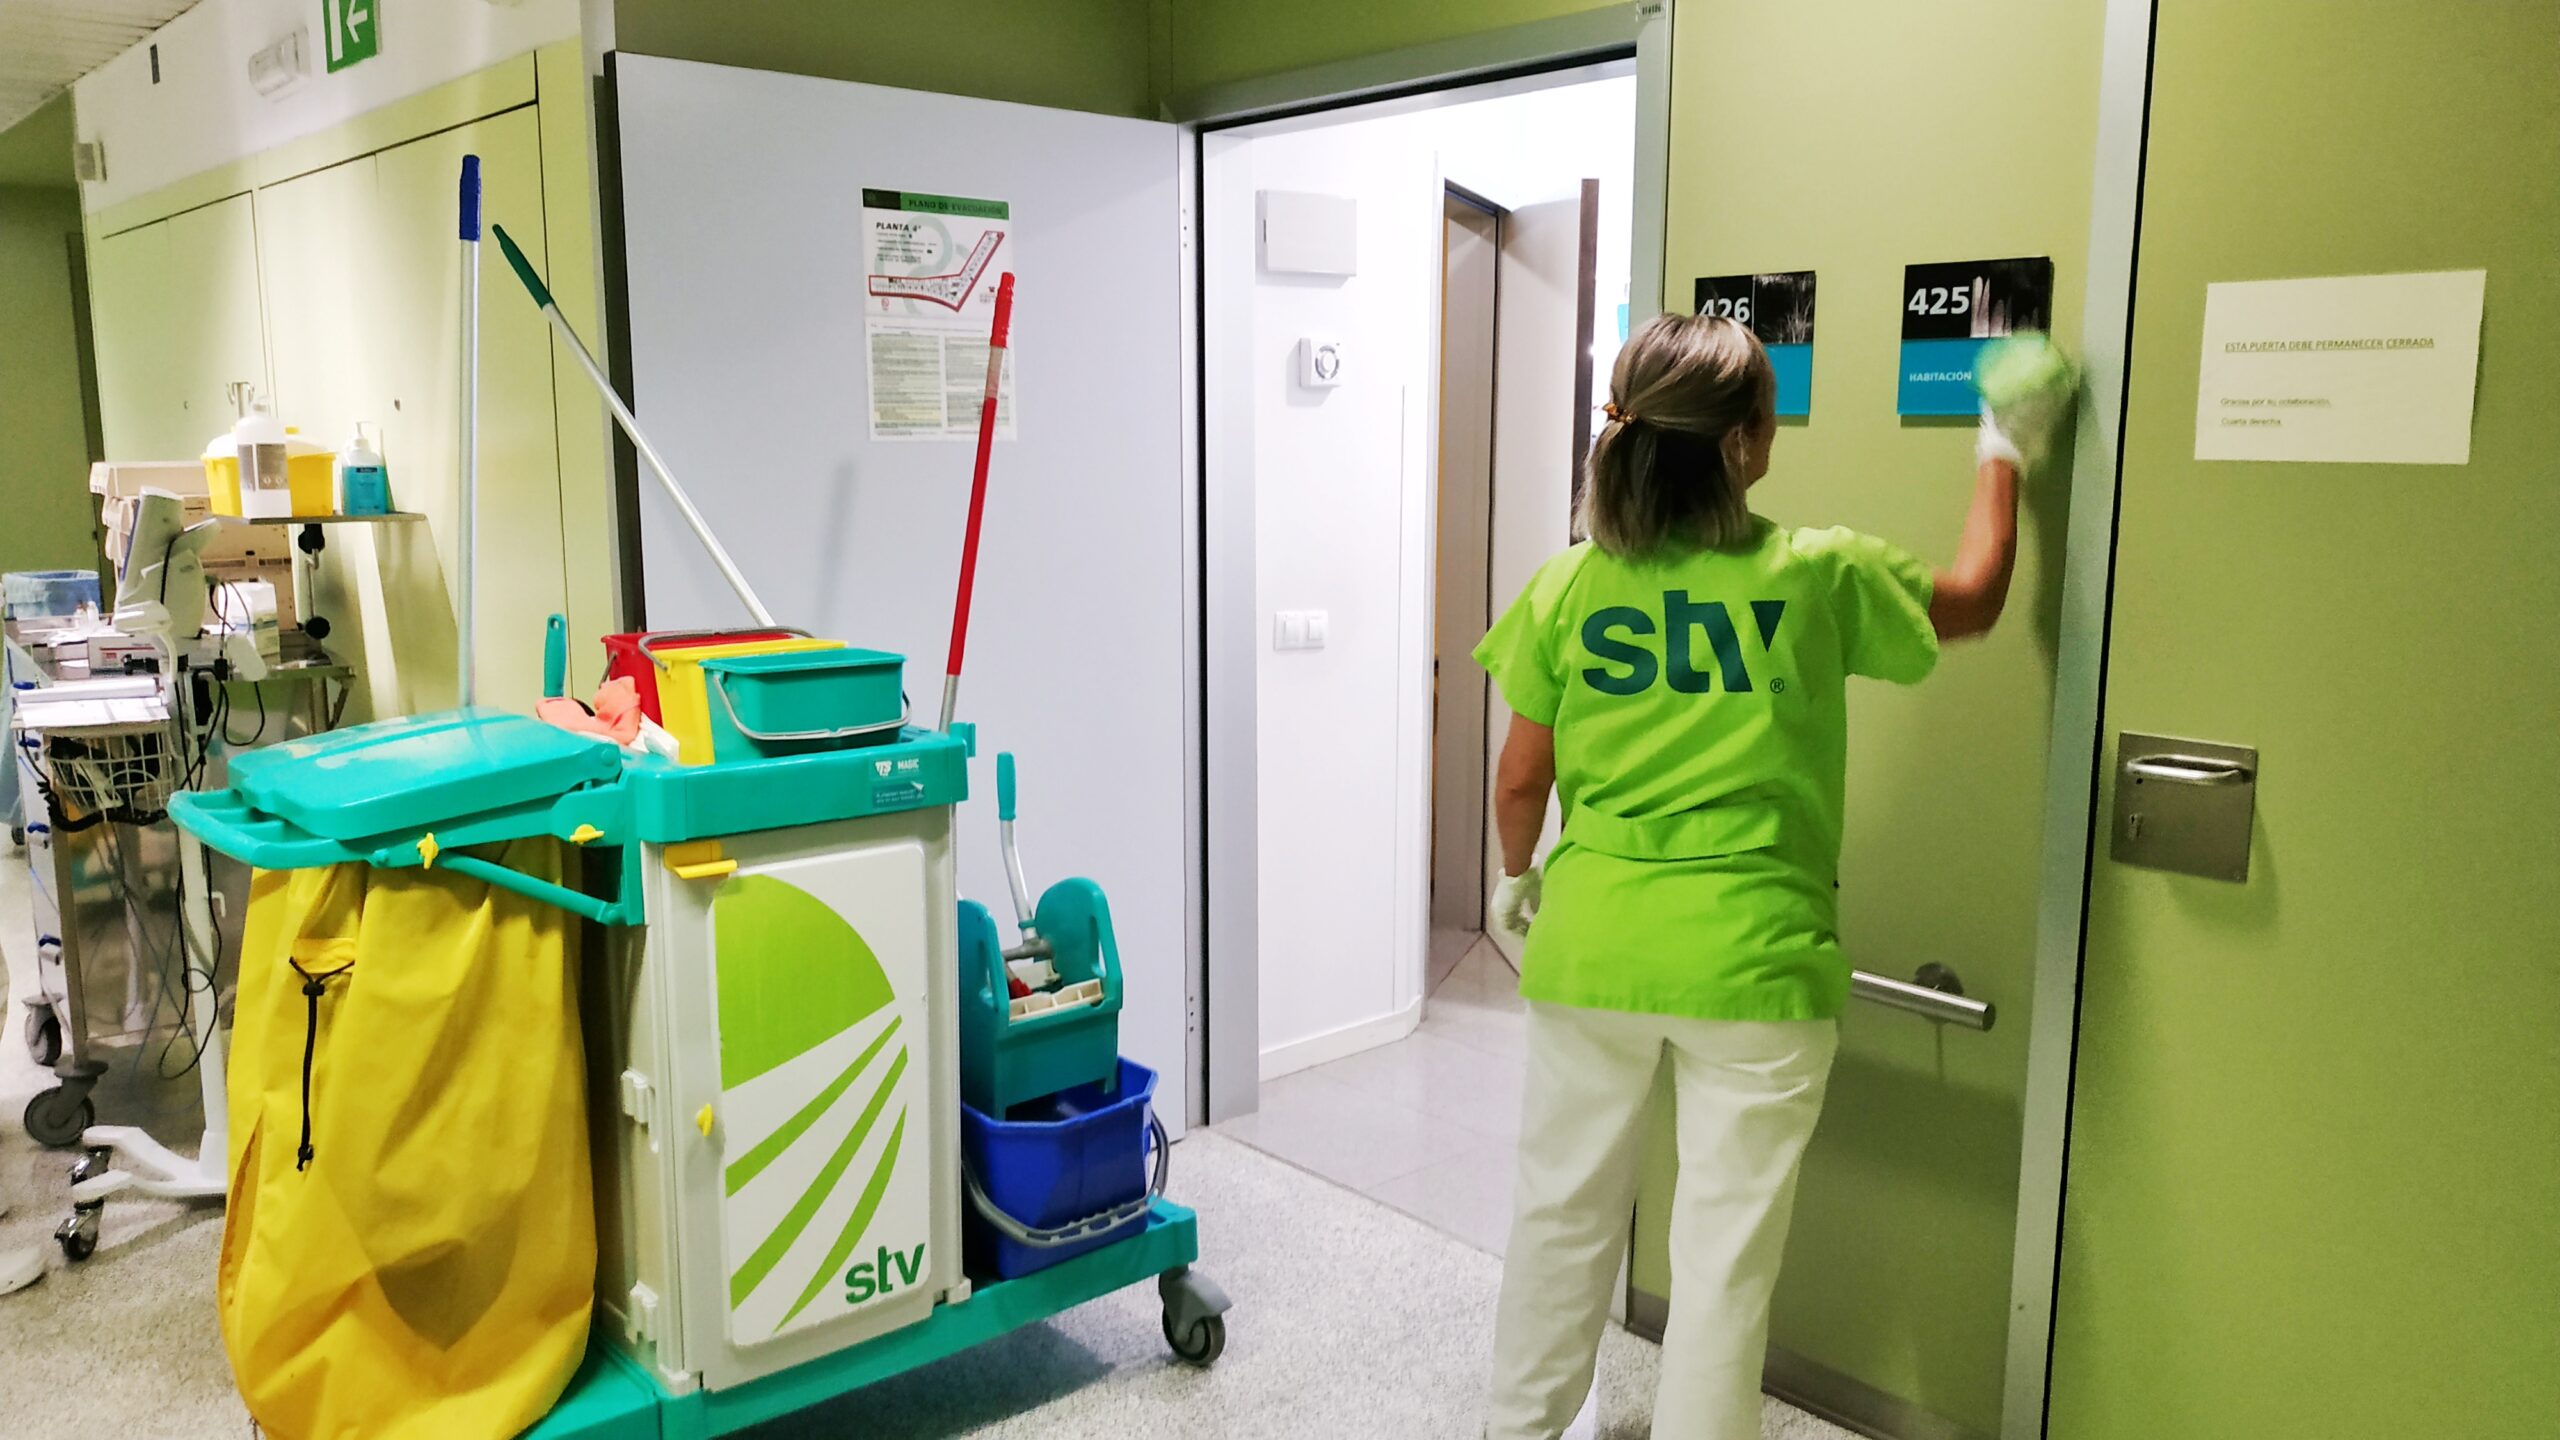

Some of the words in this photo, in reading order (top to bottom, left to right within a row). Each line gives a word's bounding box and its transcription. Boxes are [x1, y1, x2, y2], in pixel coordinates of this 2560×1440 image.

[909, 199, 936, 209] PLANO
[938, 202, 949, 210] DE
[876, 222, 909, 232] PLANTA
[1908, 286, 1970, 315] 425
[1699, 297, 1750, 323] 426
[2225, 342, 2247, 353] ESTA
[2249, 341, 2286, 352] PUERTA
[2287, 340, 2313, 351] DEBE
[2315, 339, 2383, 351] PERMANECER
[2386, 337, 2434, 349] CERRADA
[1909, 370, 1972, 382] HABITACIÓN
[898, 758, 920, 770] MAGIC
[845, 1242, 925, 1304] stv
